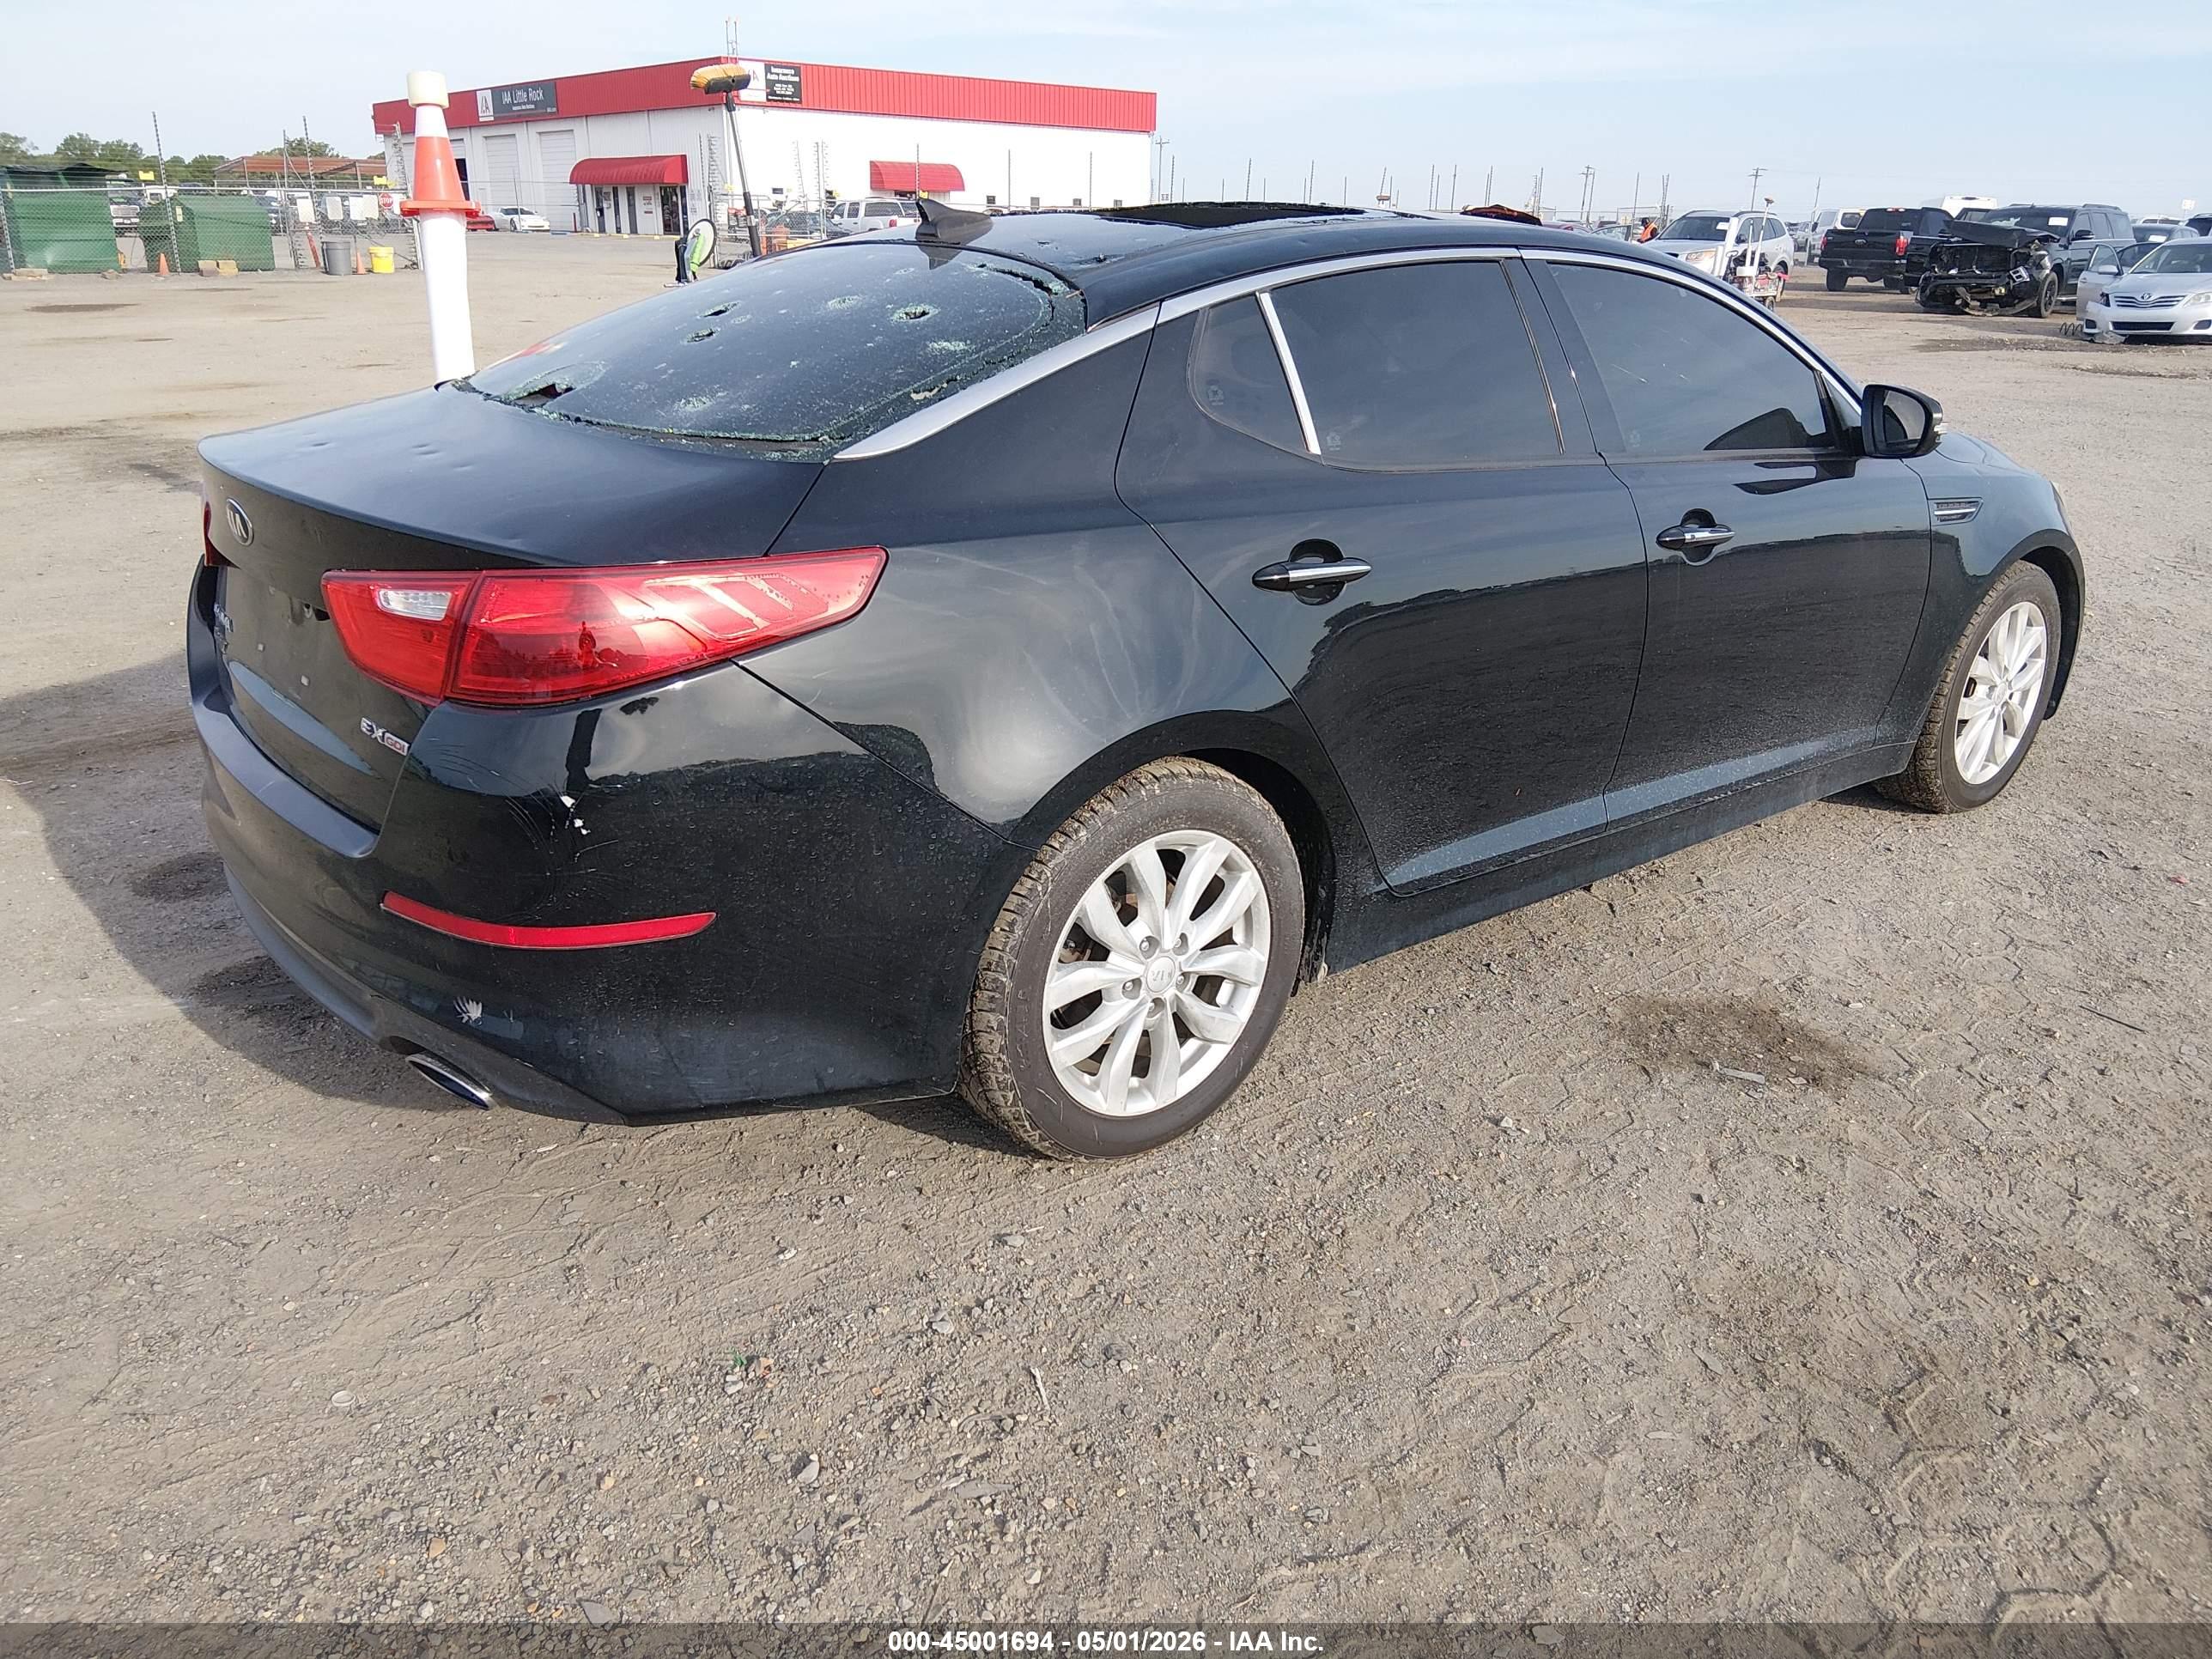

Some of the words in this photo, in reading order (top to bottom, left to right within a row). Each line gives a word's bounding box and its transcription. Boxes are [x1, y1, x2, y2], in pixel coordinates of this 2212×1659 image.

[502, 91, 512, 104] IAA
[512, 88, 527, 103] Little
[528, 87, 544, 101] Rock
